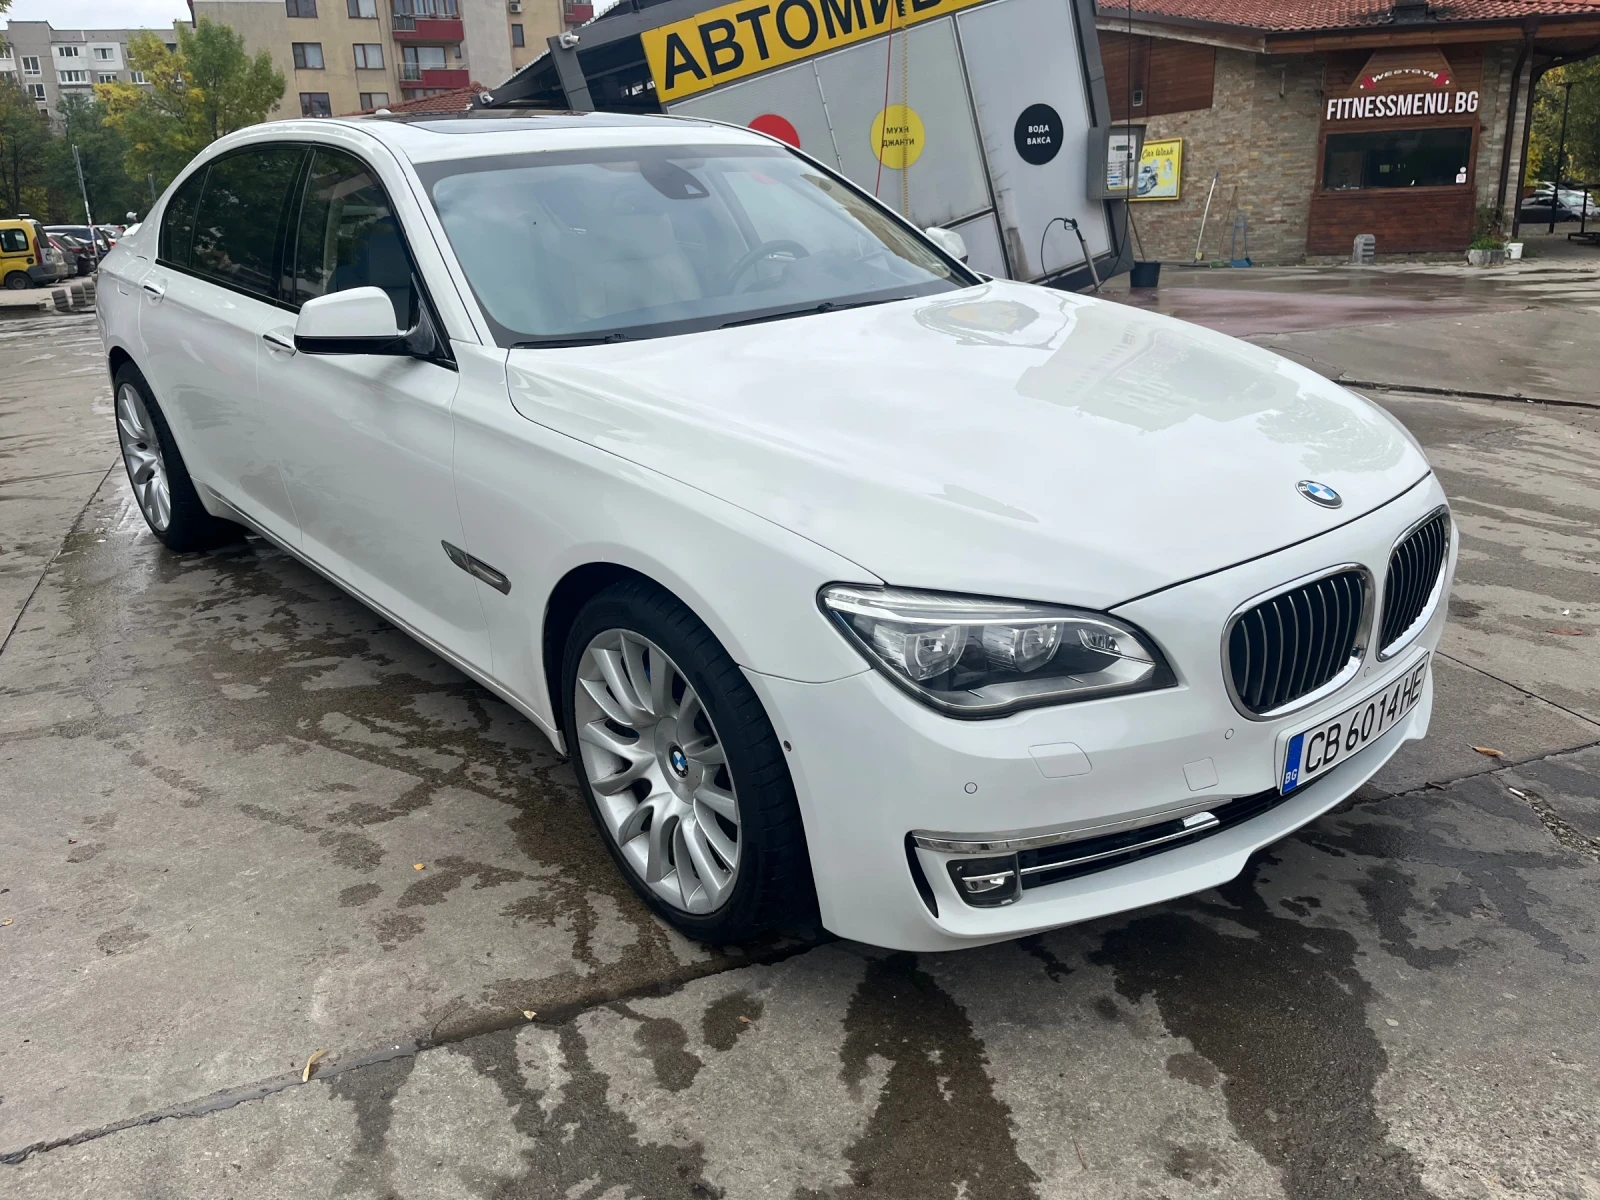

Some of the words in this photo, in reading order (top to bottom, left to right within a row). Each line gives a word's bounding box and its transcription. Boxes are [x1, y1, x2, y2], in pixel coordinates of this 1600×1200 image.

[1326, 90, 1479, 121] FITNESSMENU.BG
[1028, 124, 1050, 134] ВОДА
[882, 138, 915, 148] ДЖАНТИ
[1026, 136, 1052, 145] ВАКСА
[1141, 148, 1154, 160] Car
[1155, 146, 1174, 157] Wash
[1284, 768, 1298, 785] BG
